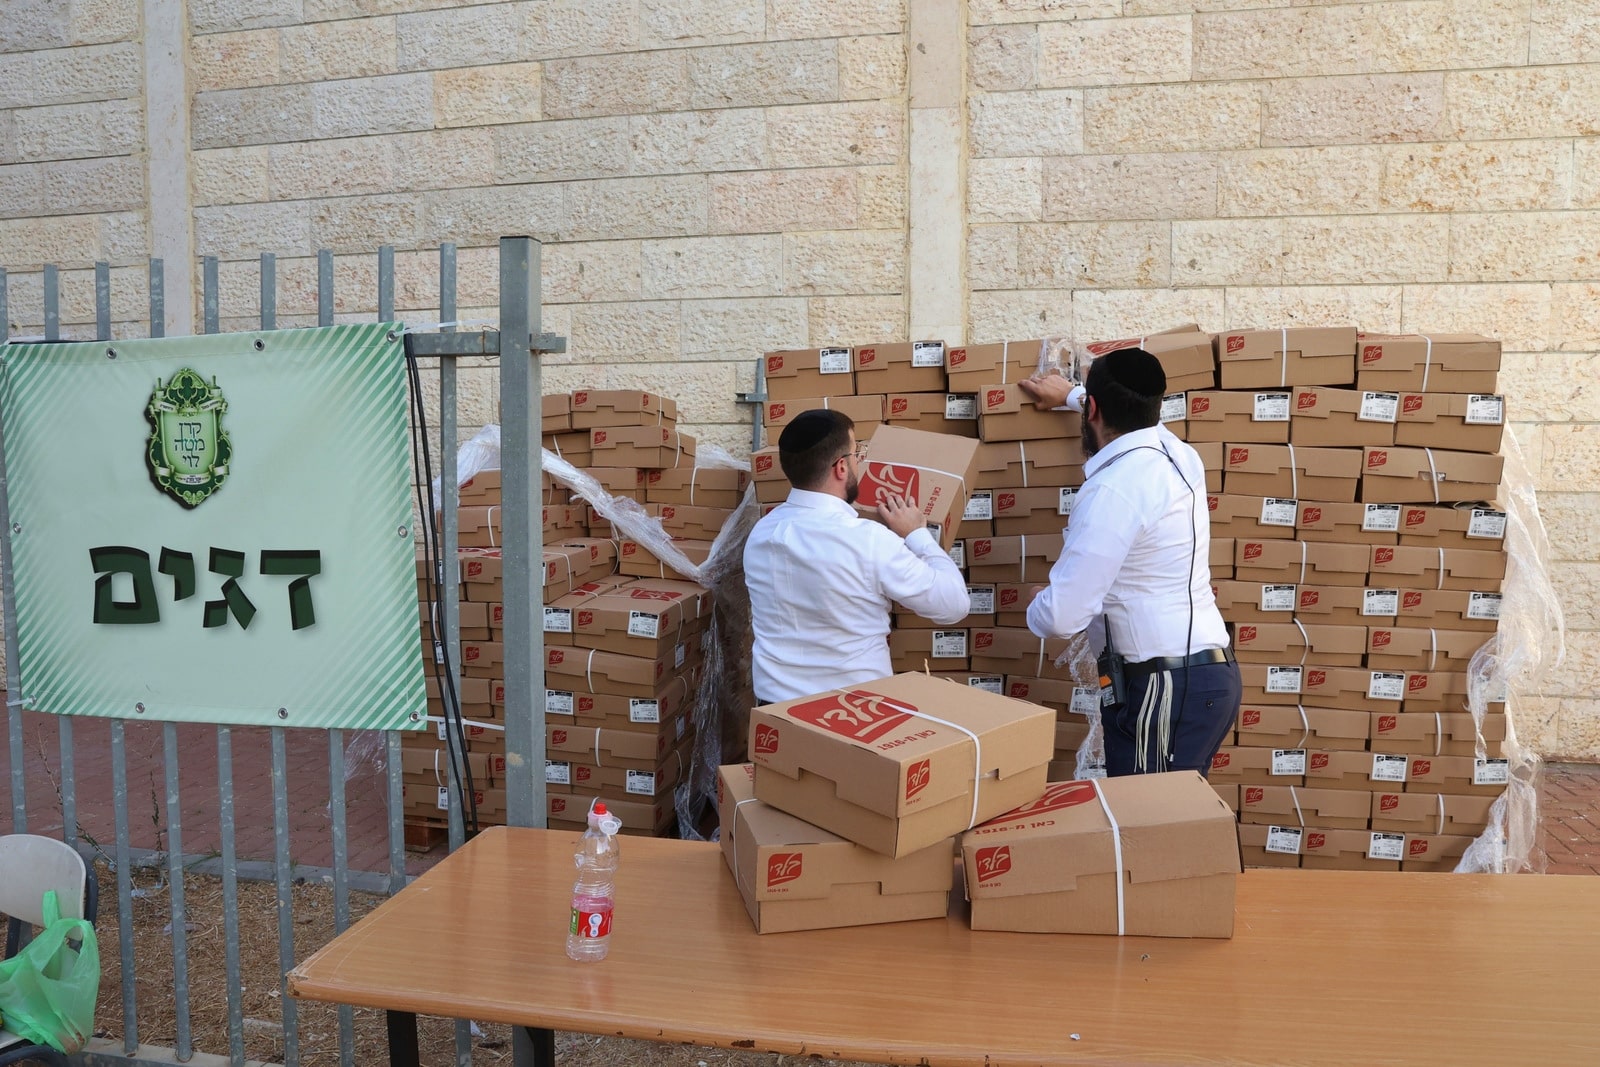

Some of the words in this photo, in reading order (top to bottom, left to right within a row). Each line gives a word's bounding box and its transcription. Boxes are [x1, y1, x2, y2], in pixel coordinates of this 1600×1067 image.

[179, 422, 202, 440] קרן
[174, 438, 205, 452] מטה
[182, 450, 200, 468] לוי
[88, 545, 321, 631] דגים
[816, 693, 886, 728] בלדי
[757, 729, 778, 747] בלדי
[908, 760, 929, 788] בלדי
[1030, 820, 1056, 829] כאן
[769, 852, 801, 877] בלדי
[978, 847, 1010, 871] בלדי
